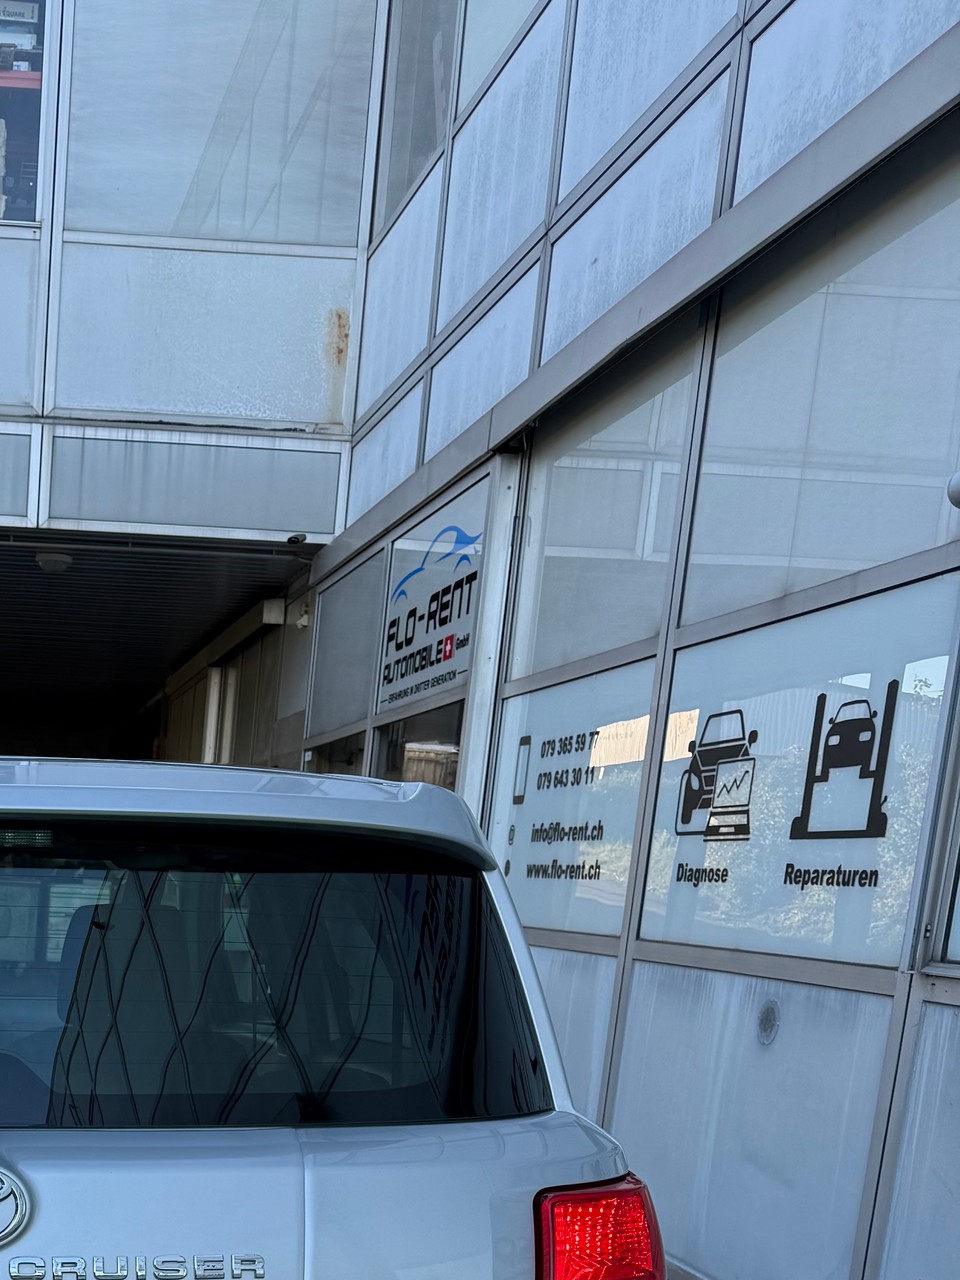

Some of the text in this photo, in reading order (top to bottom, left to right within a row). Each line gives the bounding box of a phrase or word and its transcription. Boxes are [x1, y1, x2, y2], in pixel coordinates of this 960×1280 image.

[385, 570, 478, 657] FLO-RENT
[382, 638, 443, 687] AUTOMOBILE
[540, 739, 555, 758] 079
[557, 735, 573, 756] 365
[575, 733, 586, 752] 59
[537, 766, 595, 790] 079 643 30 11
[531, 820, 604, 845] info@flo-rent.ch
[526, 859, 601, 880] www.flo-rent.ch
[676, 863, 879, 891] Diagnose Reparaturen
